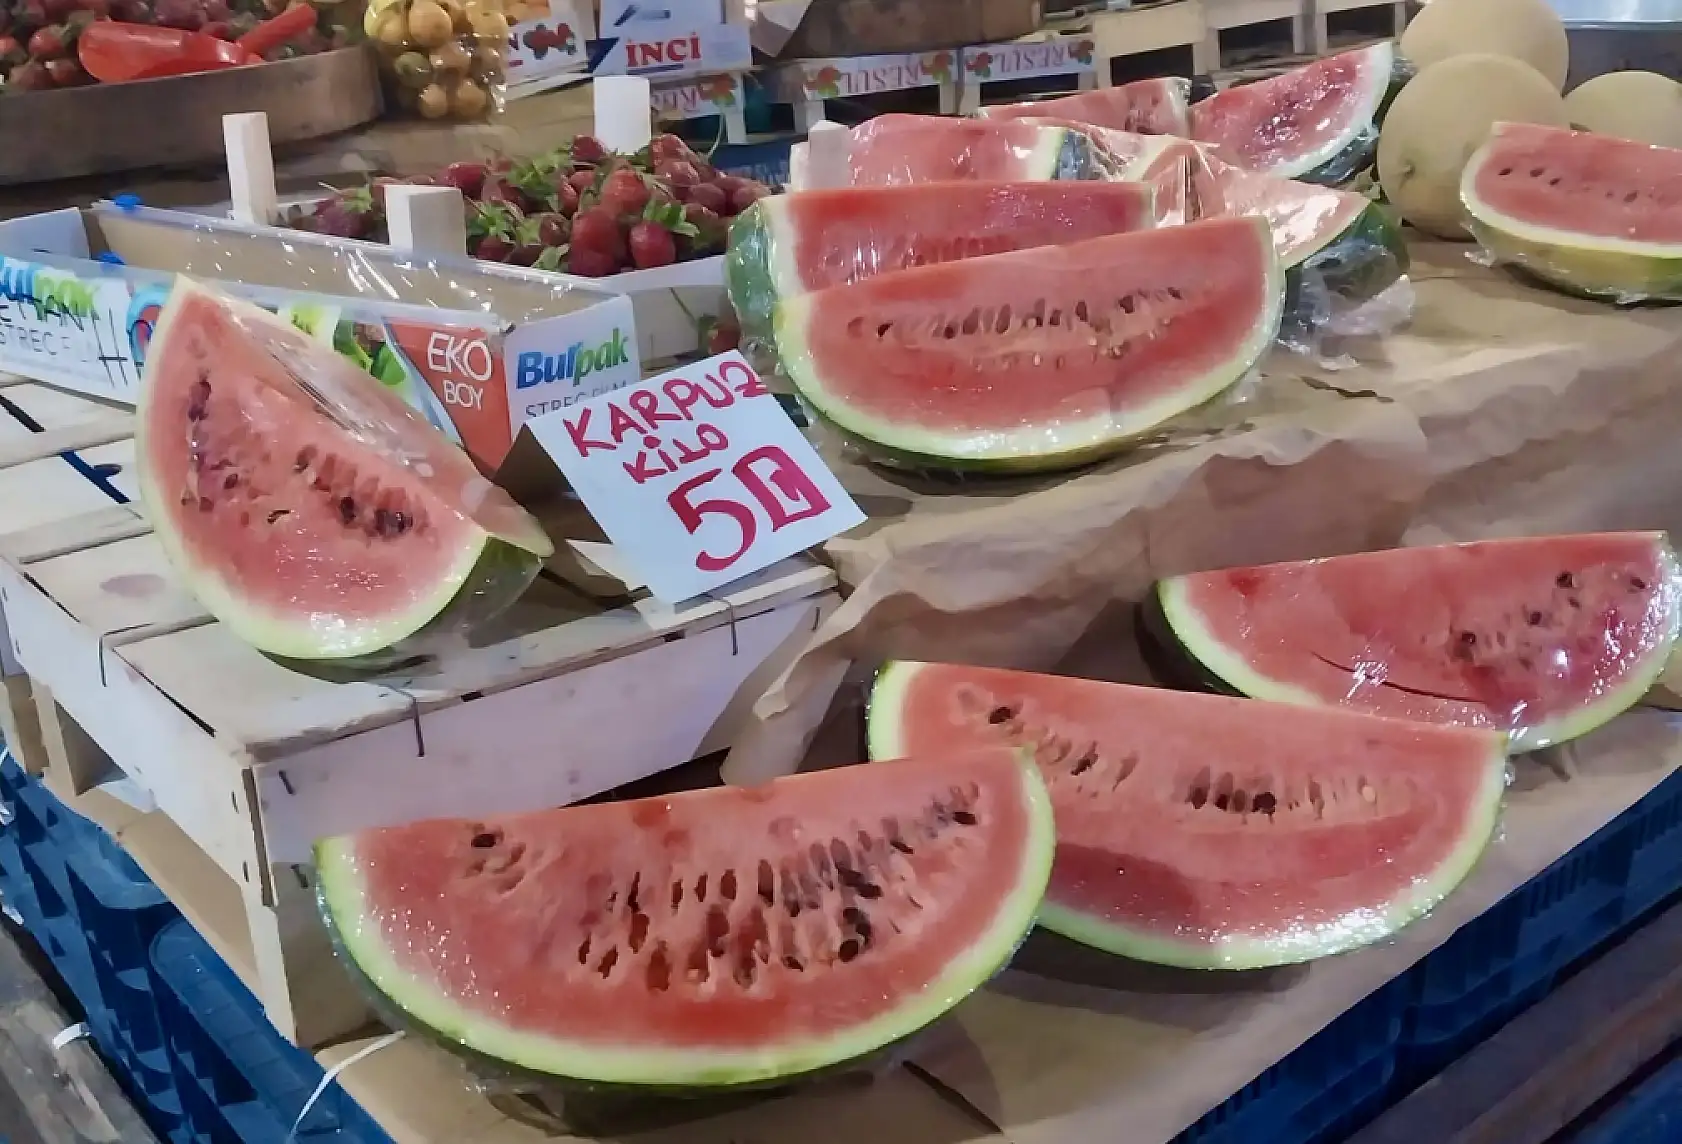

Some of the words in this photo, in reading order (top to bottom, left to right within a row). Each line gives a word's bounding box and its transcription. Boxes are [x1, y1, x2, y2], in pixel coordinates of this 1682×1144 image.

[427, 331, 492, 381] EKO
[443, 379, 484, 411] BOY
[562, 361, 768, 457] KARPUZ
